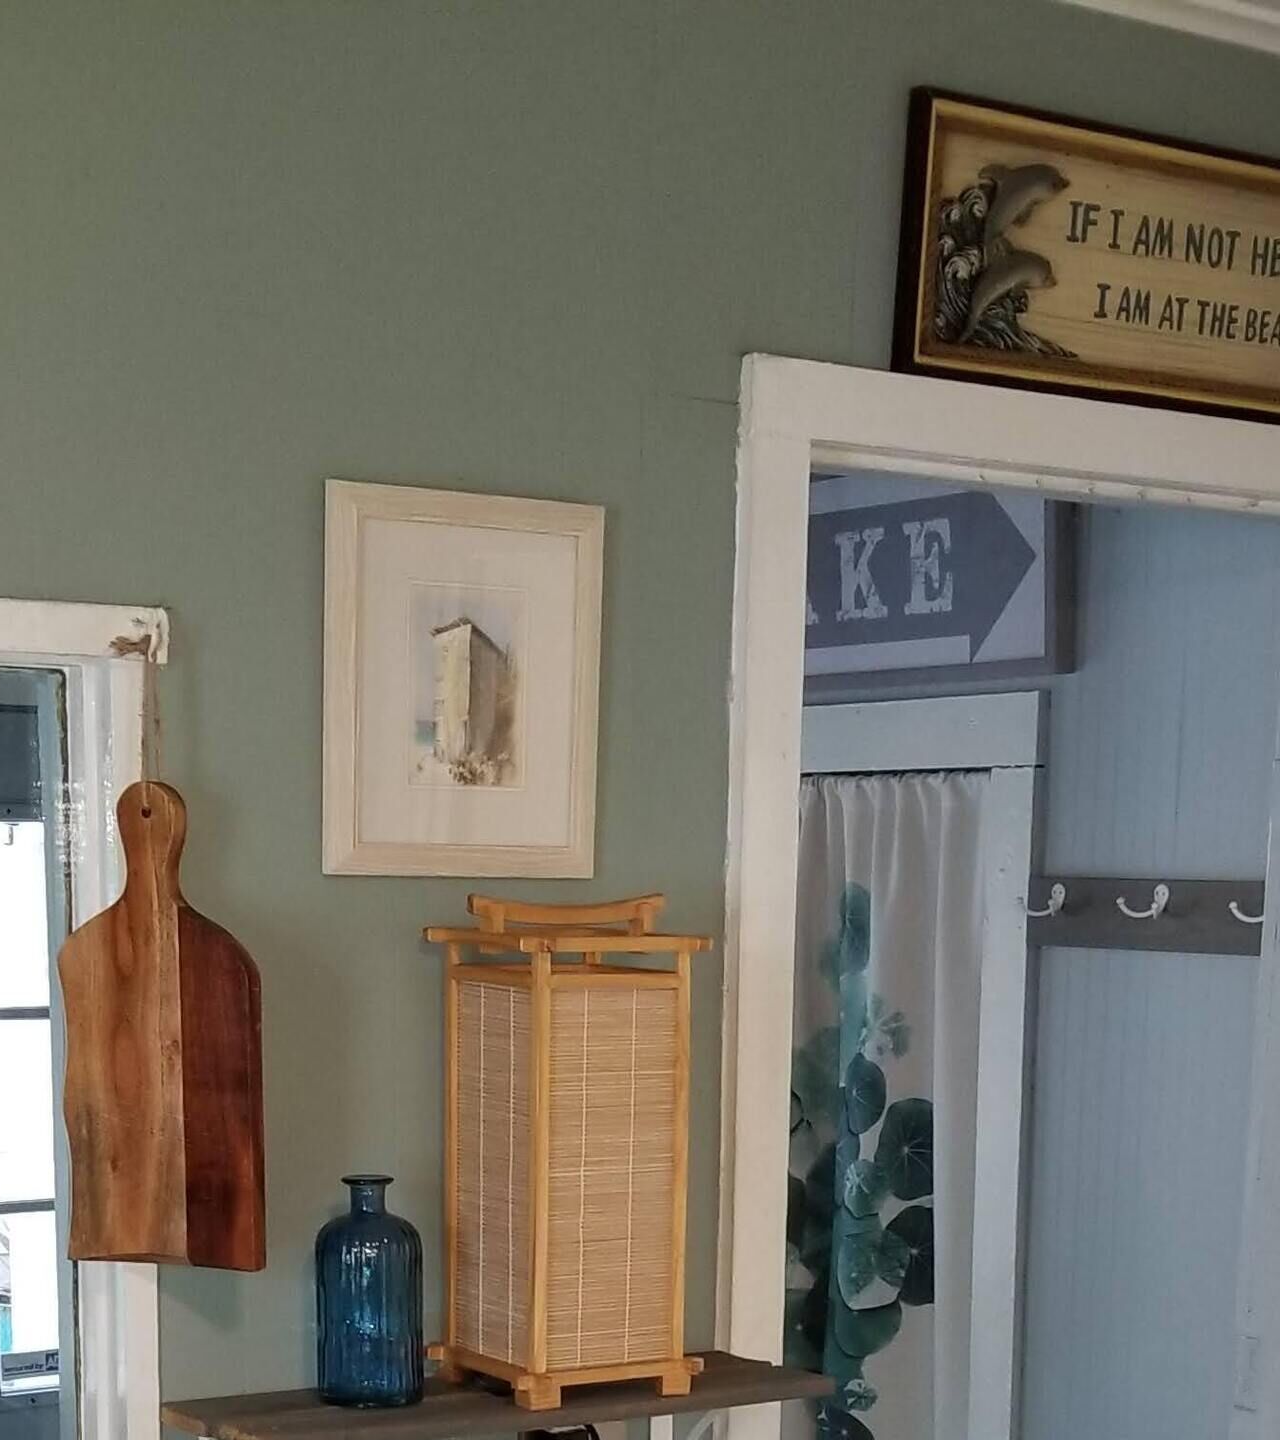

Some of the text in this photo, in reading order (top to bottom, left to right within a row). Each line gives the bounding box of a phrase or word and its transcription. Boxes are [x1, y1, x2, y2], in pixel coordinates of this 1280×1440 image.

[1066, 200, 1100, 243] IF
[1107, 208, 1125, 249] I
[1132, 215, 1173, 258] AM
[1184, 223, 1241, 271] NOT
[1094, 283, 1111, 318] I
[1116, 287, 1150, 325] AM
[1158, 294, 1189, 332] AT
[1197, 299, 1239, 339] THE
[806, 518, 953, 625] KE
